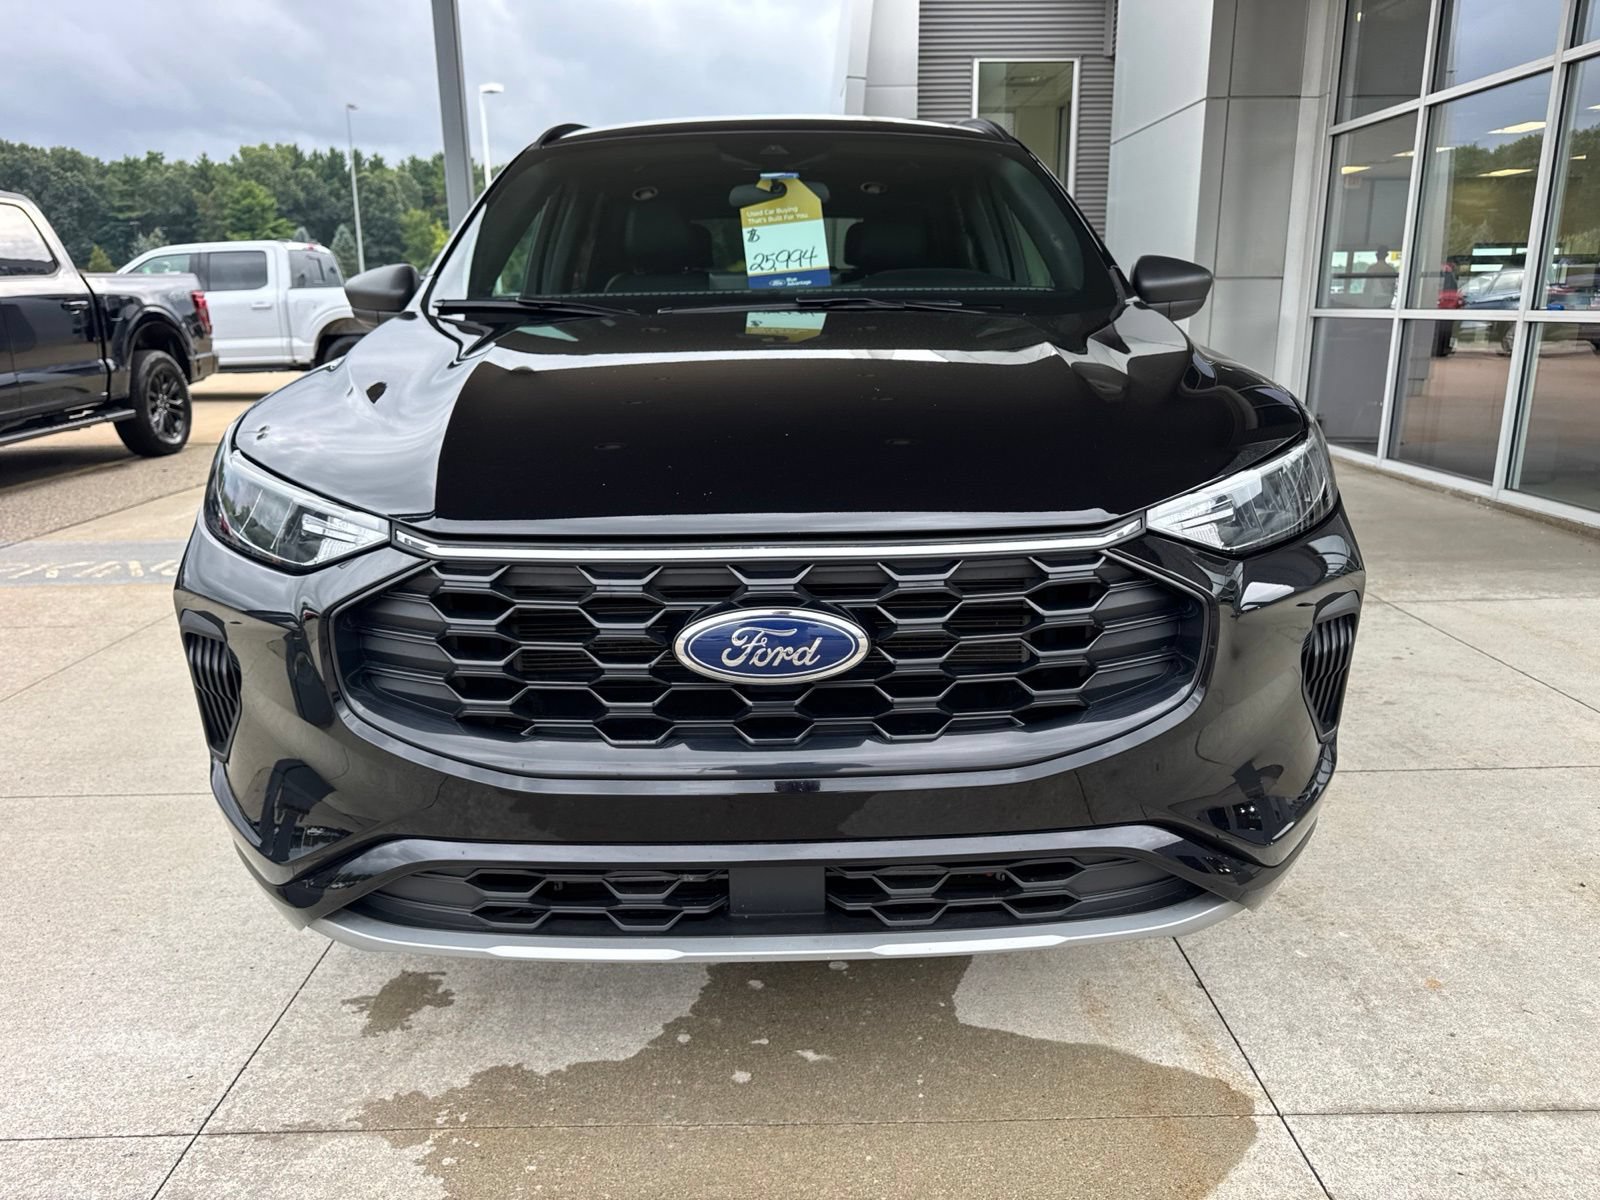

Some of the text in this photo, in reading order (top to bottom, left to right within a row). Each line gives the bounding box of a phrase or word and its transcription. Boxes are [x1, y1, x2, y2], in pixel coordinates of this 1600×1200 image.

[747, 210, 763, 218] Used
[776, 206, 798, 214] Buying
[721, 626, 823, 667] Ford
